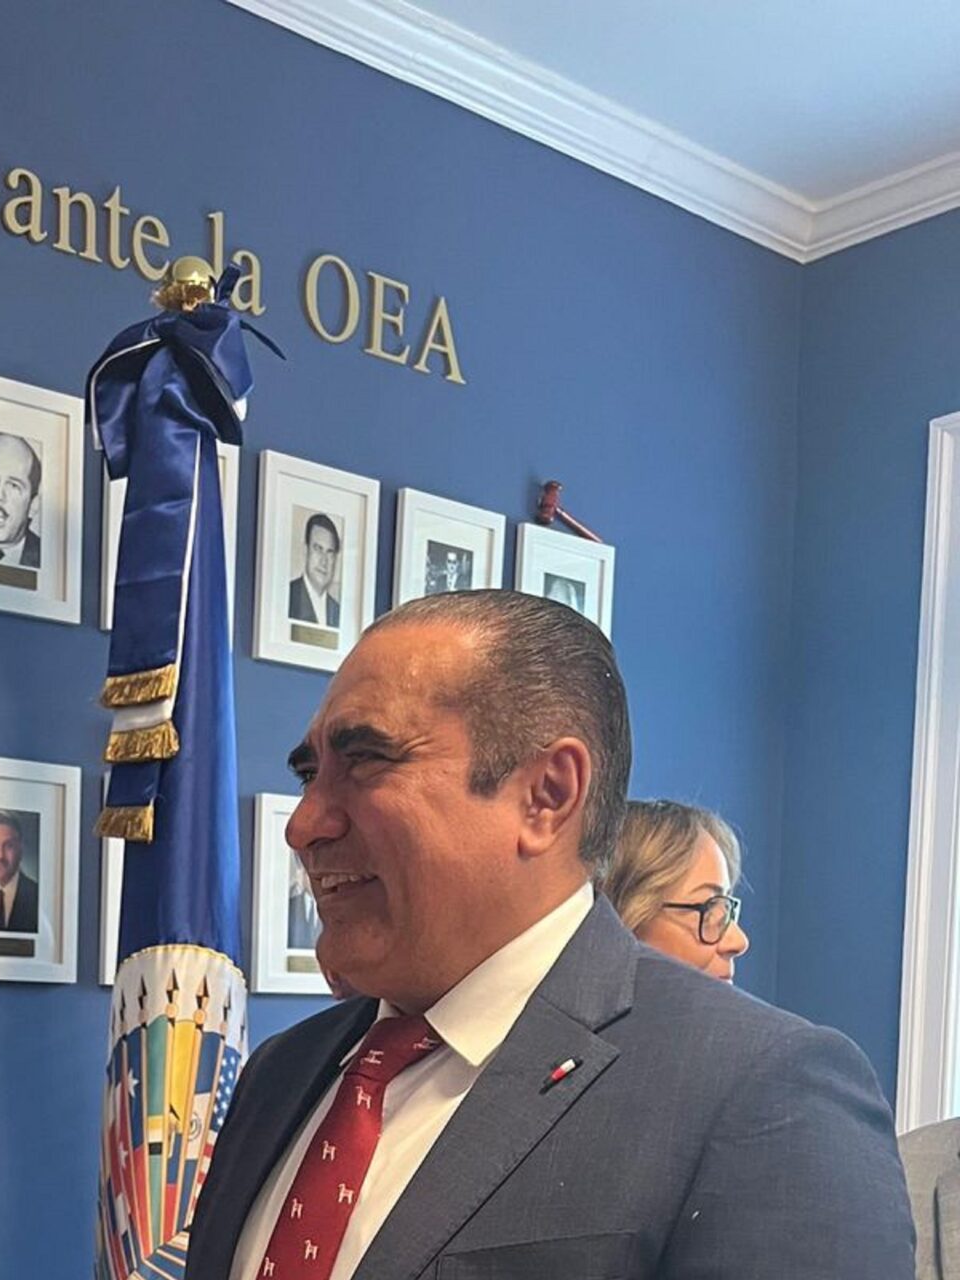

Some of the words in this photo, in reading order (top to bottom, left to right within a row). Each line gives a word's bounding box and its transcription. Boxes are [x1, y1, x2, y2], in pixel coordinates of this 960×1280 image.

[2, 167, 171, 282] ante
[207, 211, 266, 316] la
[305, 254, 467, 386] OEA
